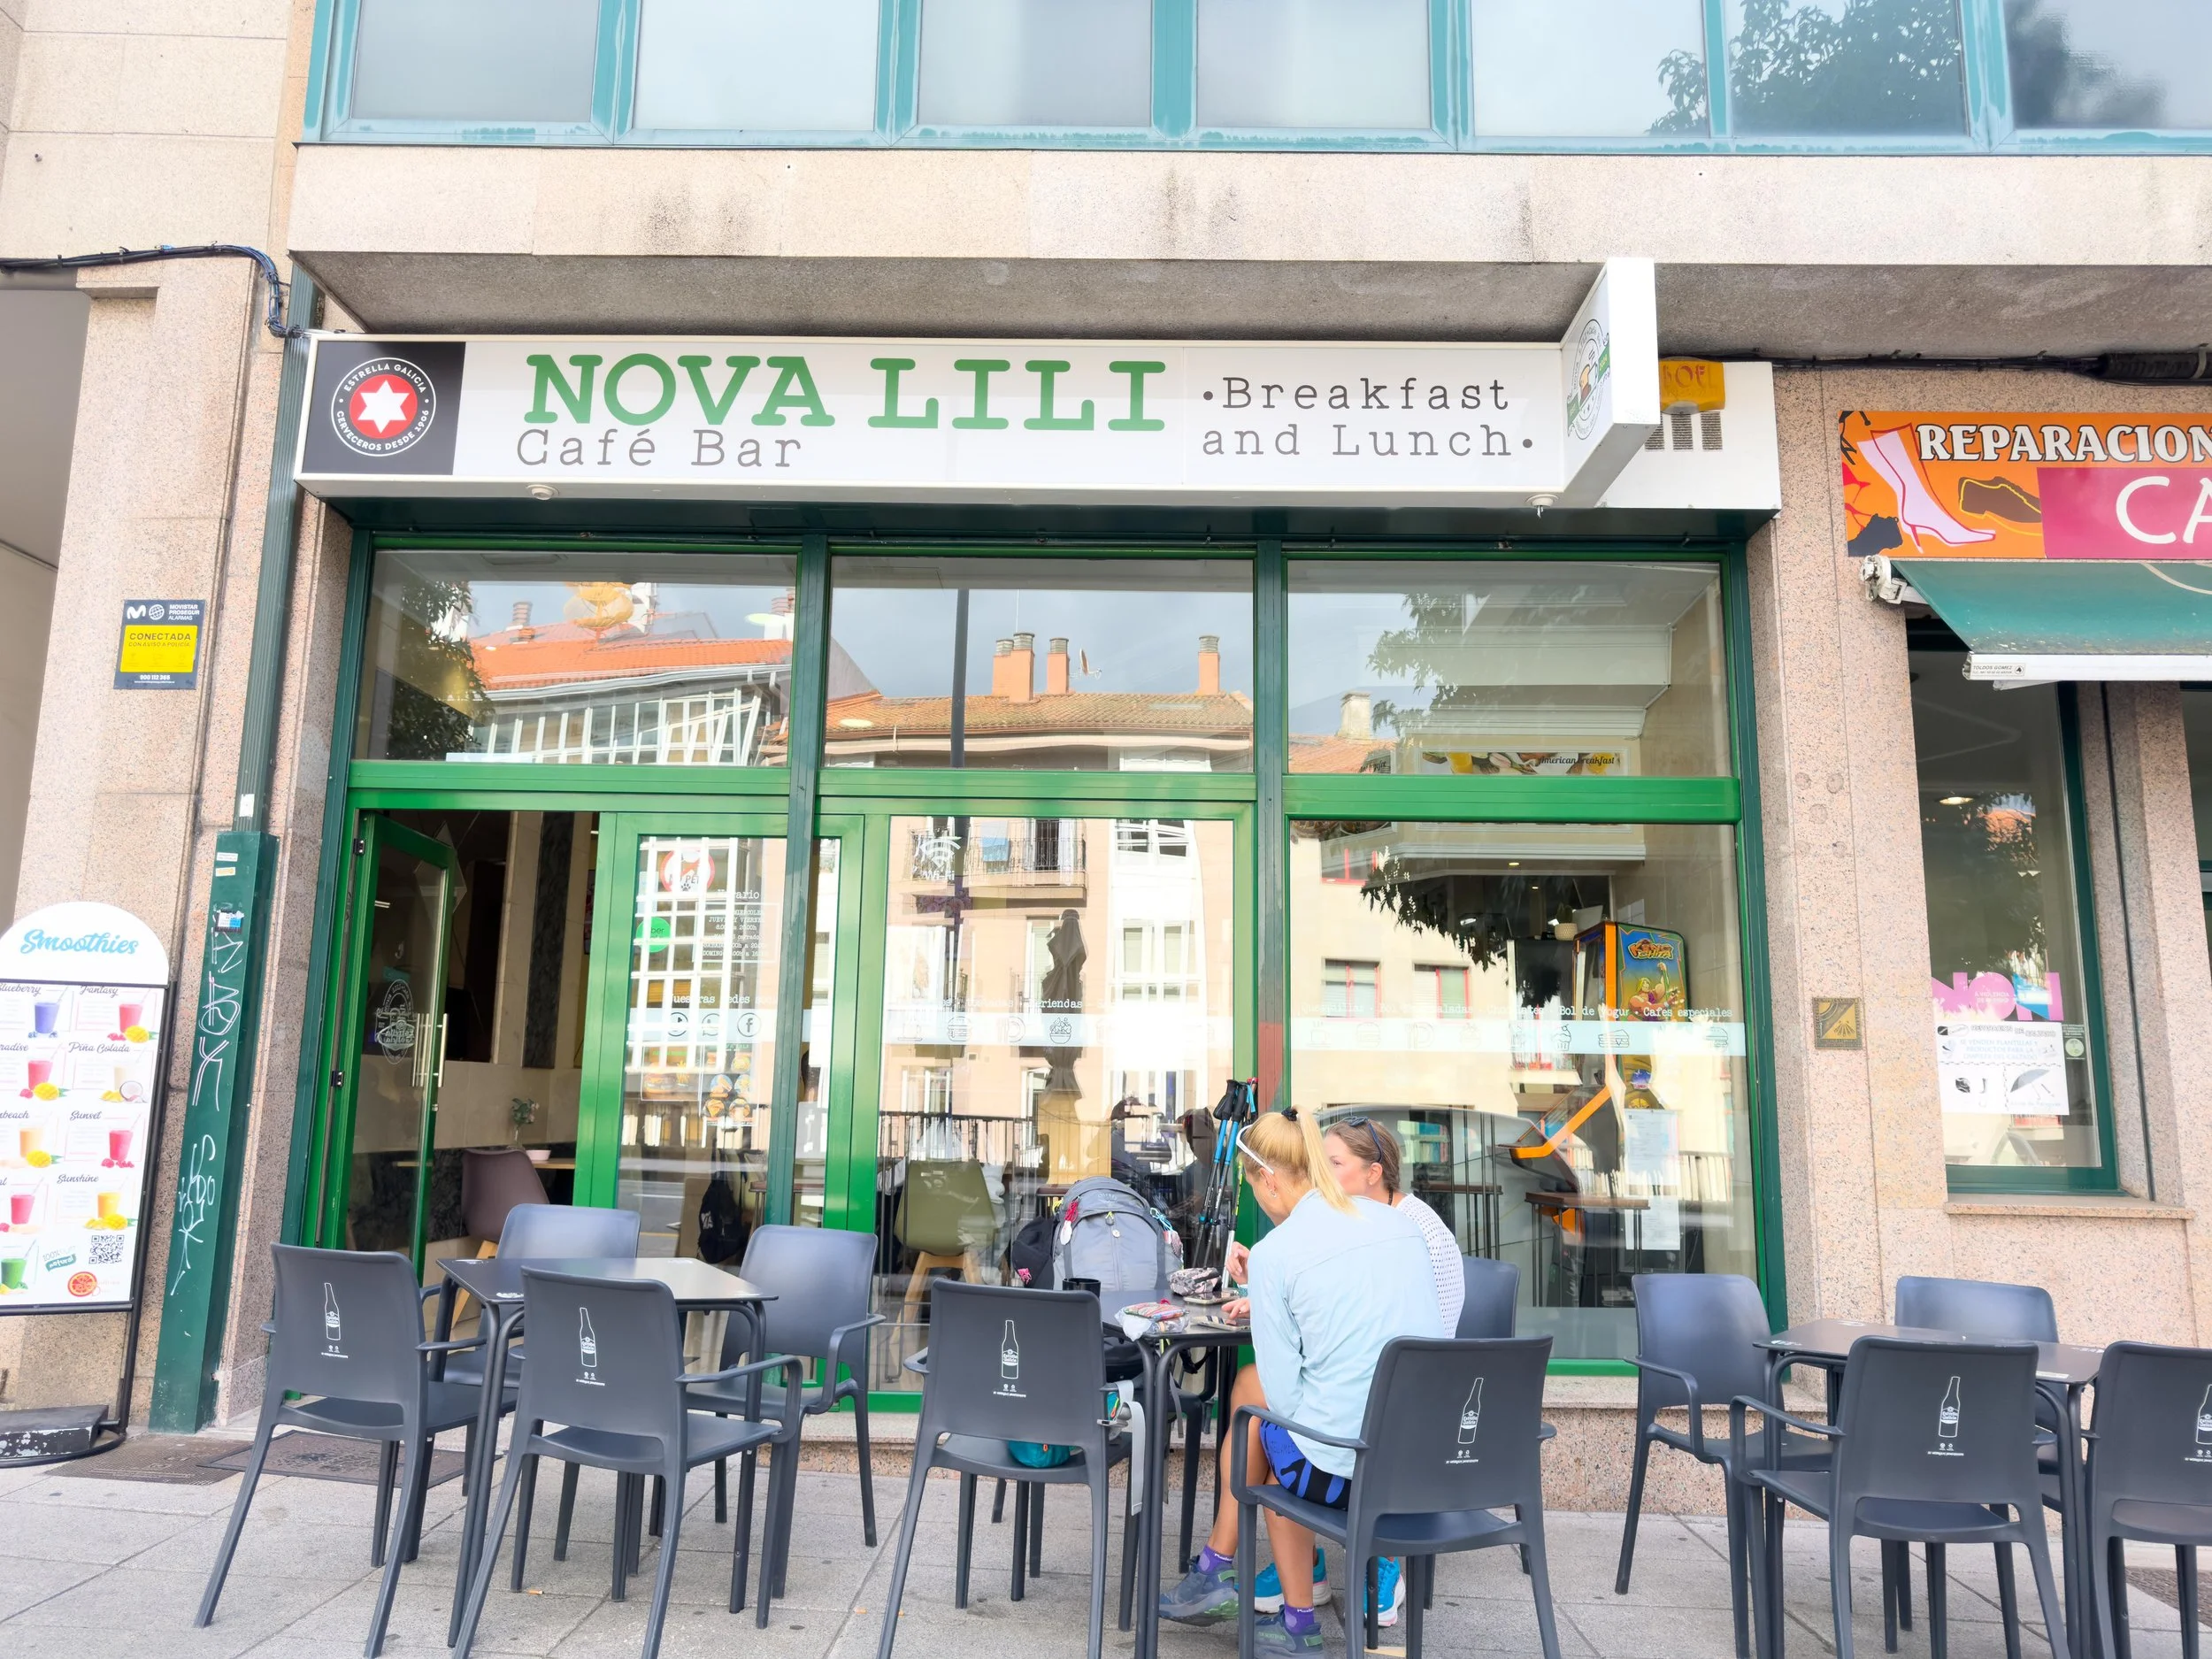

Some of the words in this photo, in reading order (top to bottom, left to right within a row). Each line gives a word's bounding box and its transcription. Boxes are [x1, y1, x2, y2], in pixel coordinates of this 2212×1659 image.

[343, 363, 390, 392] ESTRELLA
[394, 364, 426, 393] GALICIA
[524, 353, 835, 426] NOVA
[867, 357, 1166, 431] LILI
[336, 411, 382, 450] CERVECEROS
[385, 431, 416, 450] DESDE
[414, 410, 429, 432] 1906
[1202, 424, 1300, 456] and
[517, 429, 657, 467] Café
[691, 430, 802, 468] Bar
[20, 929, 139, 954] Smoothies
[80, 985, 119, 998] Fantasy
[1559, 1005, 1576, 1016] Bol
[1581, 1005, 1594, 1017] de
[1677, 1007, 1733, 1020] especiales
[68, 1041, 95, 1053] Piña
[96, 1042, 130, 1054] Colada
[69, 1110, 102, 1121] Sunset
[57, 1174, 99, 1184] Sunshine
[49, 1255, 74, 1269] natural
